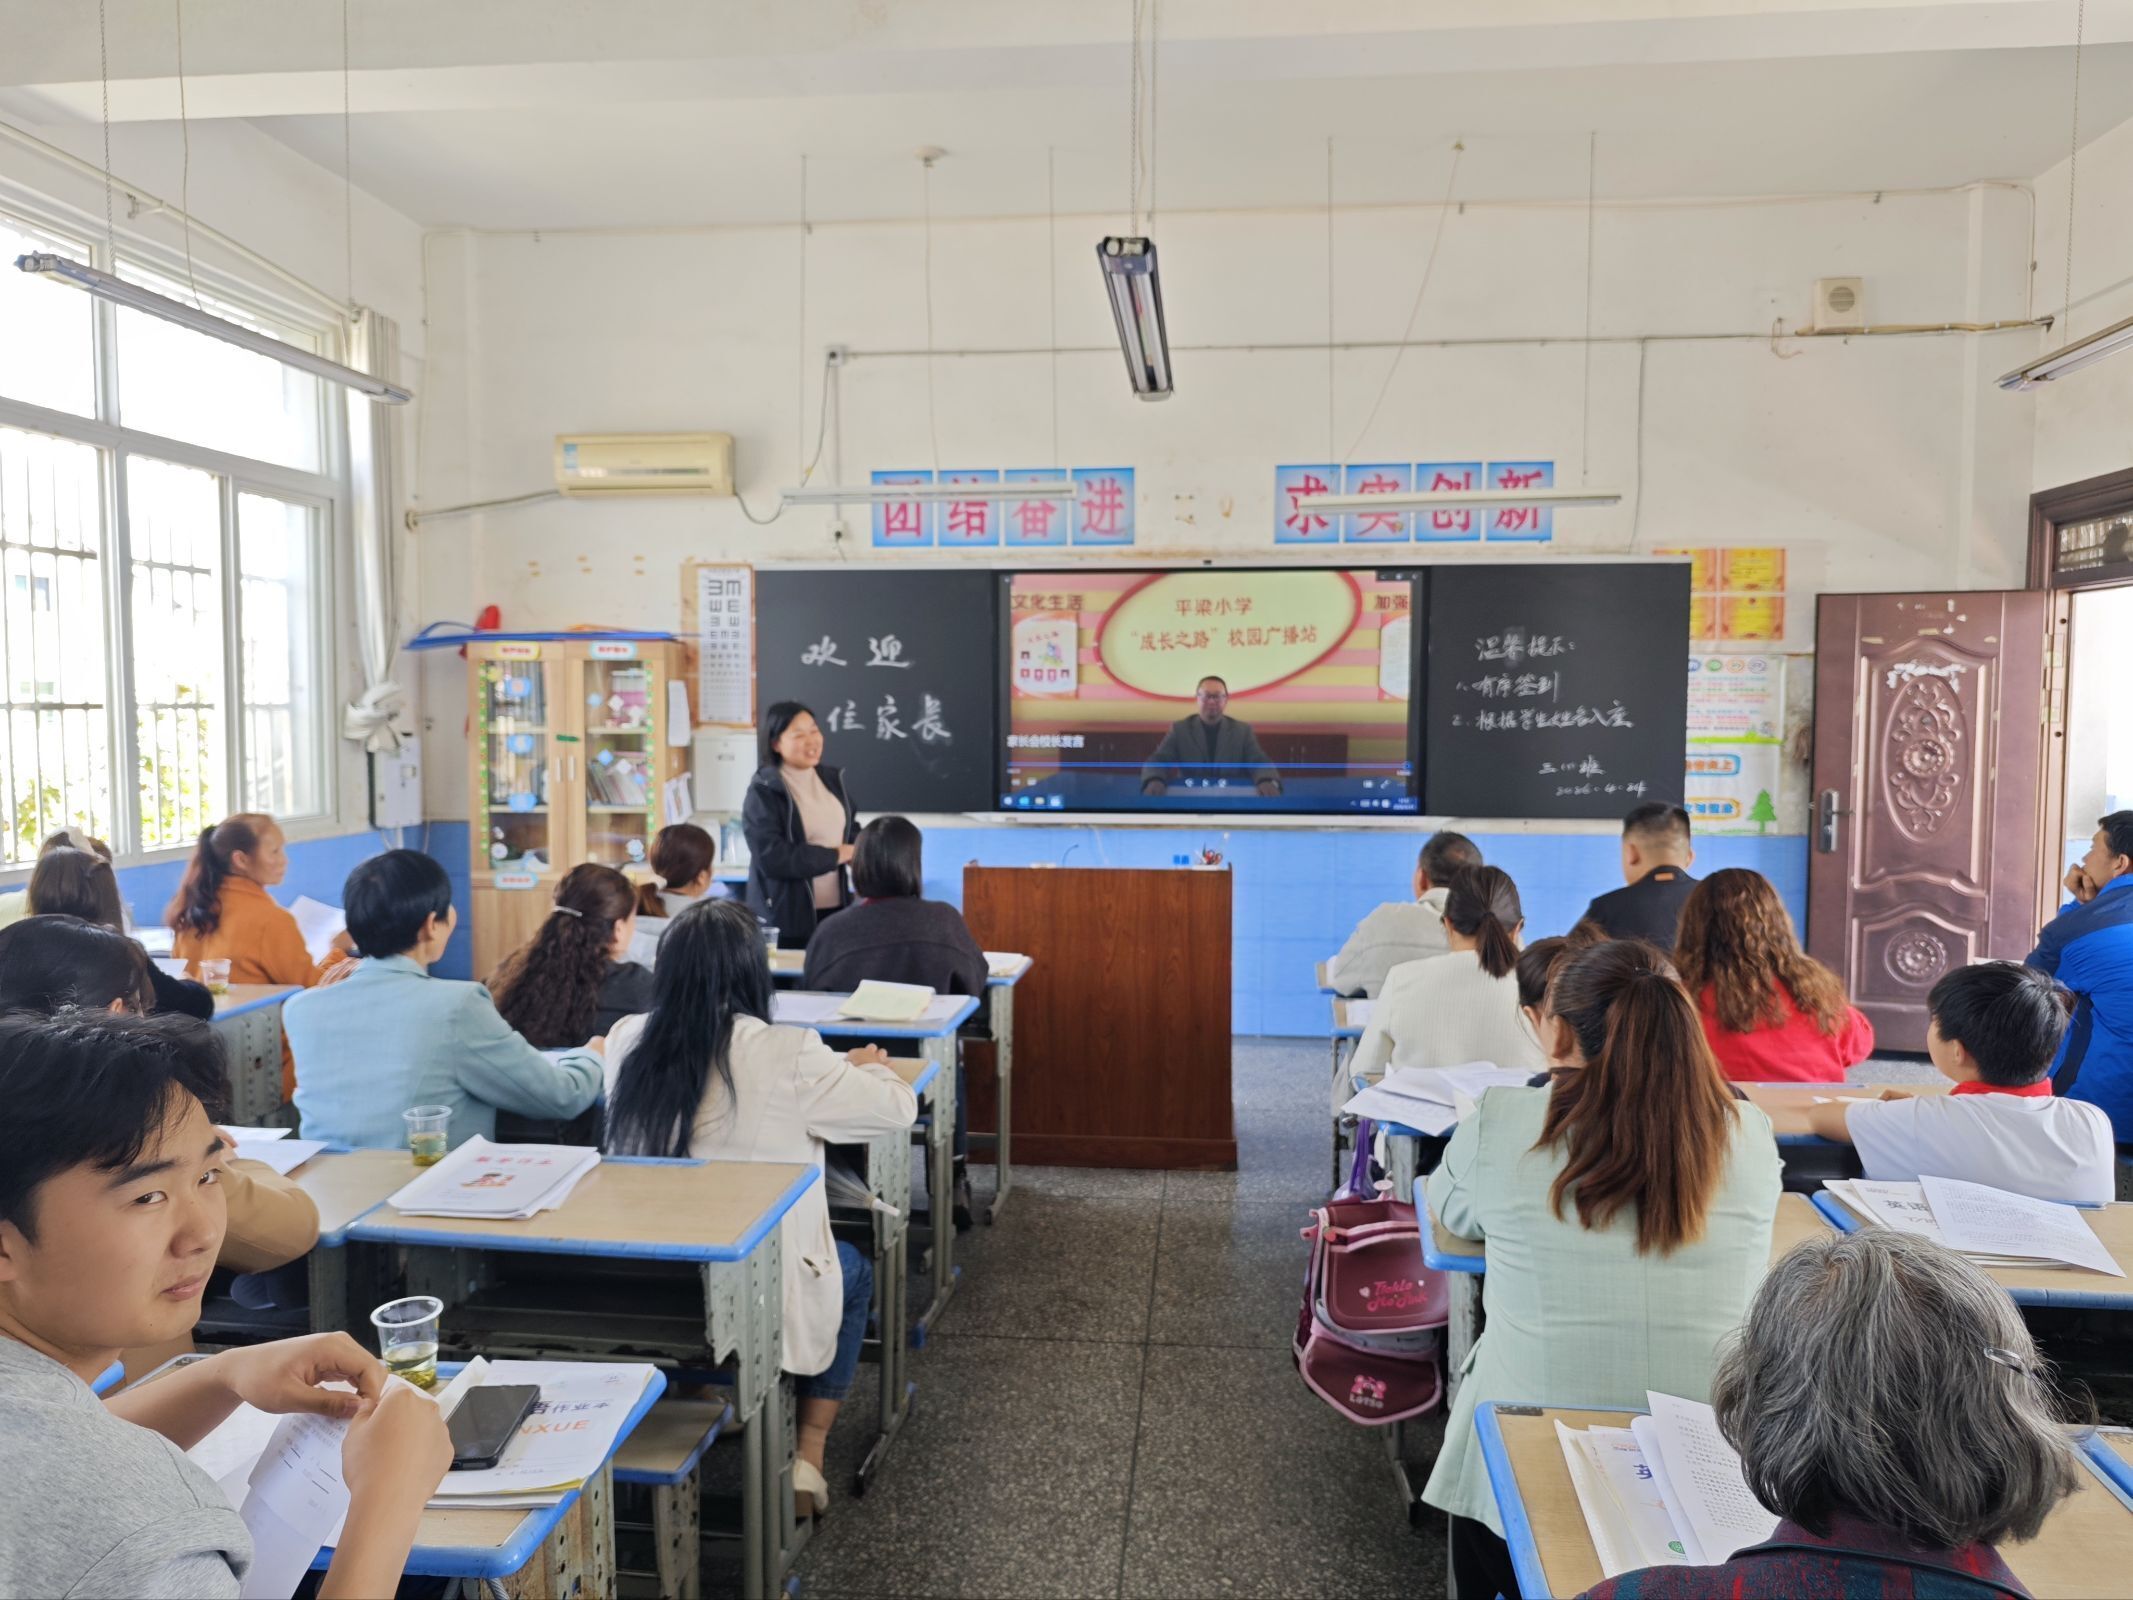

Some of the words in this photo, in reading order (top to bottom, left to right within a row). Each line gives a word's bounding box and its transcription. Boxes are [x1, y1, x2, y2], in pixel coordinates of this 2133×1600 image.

[882, 476, 1126, 538] 团结奋进
[1284, 468, 1543, 536] 求实创新
[1011, 594, 1084, 611] 文化生活
[1174, 598, 1253, 616] 平梁小学
[1228, 624, 1318, 648] 校园广播站
[801, 635, 911, 668] 欢迎
